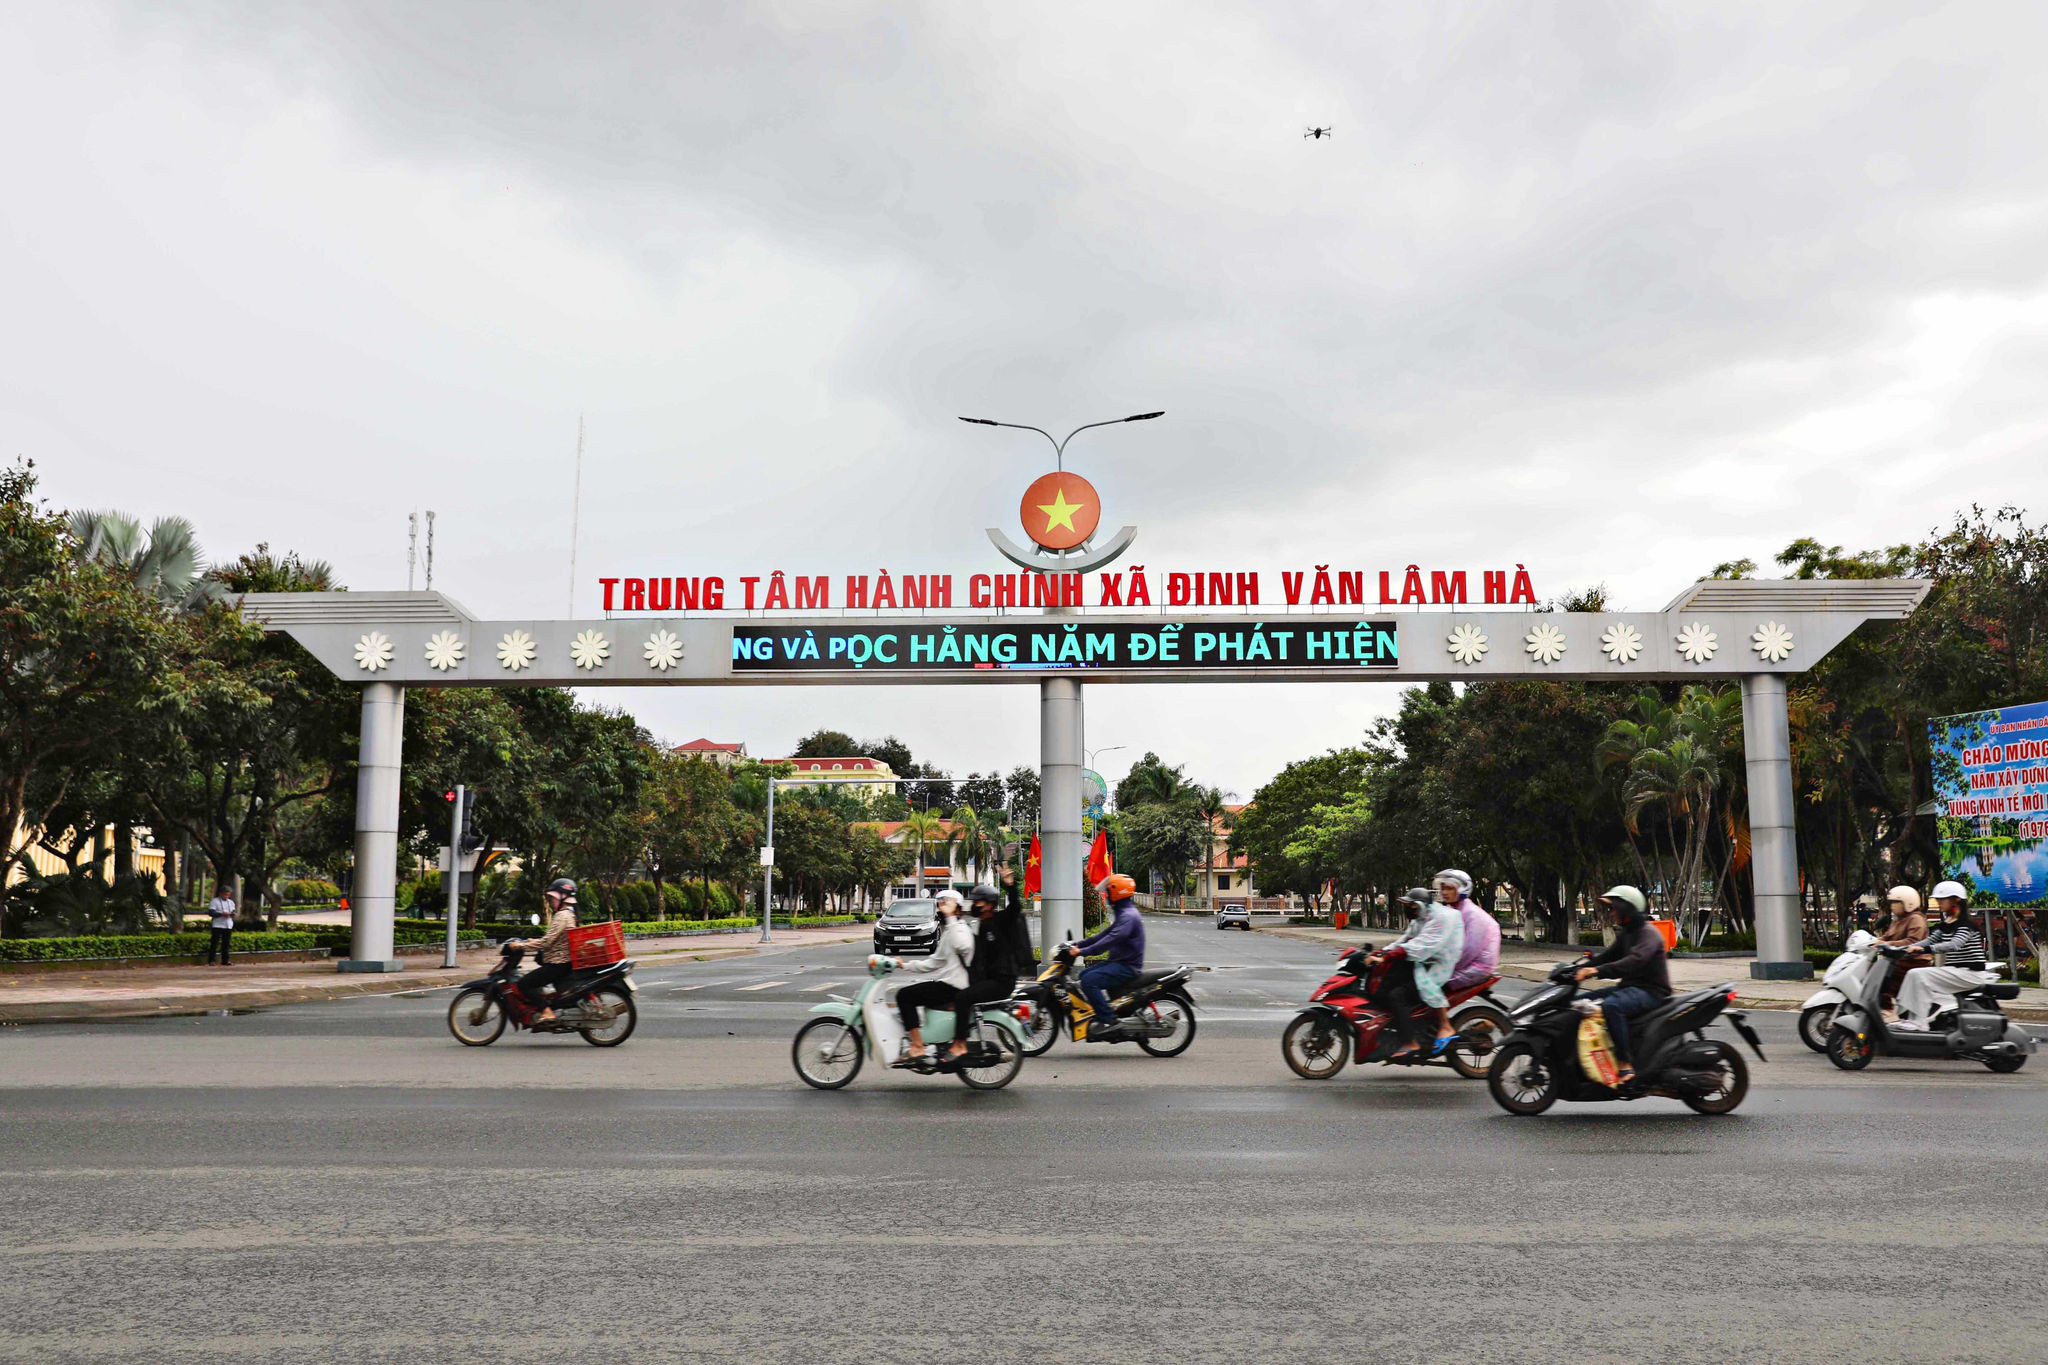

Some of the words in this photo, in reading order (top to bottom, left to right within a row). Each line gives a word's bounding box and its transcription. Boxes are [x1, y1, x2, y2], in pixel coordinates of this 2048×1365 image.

[599, 577, 724, 610] TRUNG
[740, 570, 829, 609] TÂM
[847, 569, 952, 608] HÀNH
[970, 567, 1083, 607] CHÍNH
[1101, 565, 1151, 607] XÃ
[1167, 572, 1259, 605] ĐINH
[1282, 564, 1363, 605] VĂN
[1379, 564, 1467, 604] LÂM
[1484, 564, 1536, 604] HÀ
[781, 630, 820, 660] VÀ
[910, 625, 1017, 662] HẰNG
[1031, 624, 1115, 662] NĂM
[1128, 623, 1184, 661] ĐỂ
[1194, 622, 1294, 661] PHÁT
[1306, 621, 1398, 665] HIỆN
[2001, 723, 2016, 733] BAN
[2017, 718, 2037, 730] NHÂN
[1962, 744, 2002, 766] CHÀO
[2005, 739, 2048, 762] MỪNG
[1971, 770, 1995, 789] NĂM
[1998, 767, 2018, 786] XÂY
[1949, 798, 1977, 816] VÙNG
[1979, 797, 2005, 814] KINH
[2007, 792, 2019, 812] TẾ
[2022, 791, 2043, 811] MỚI
